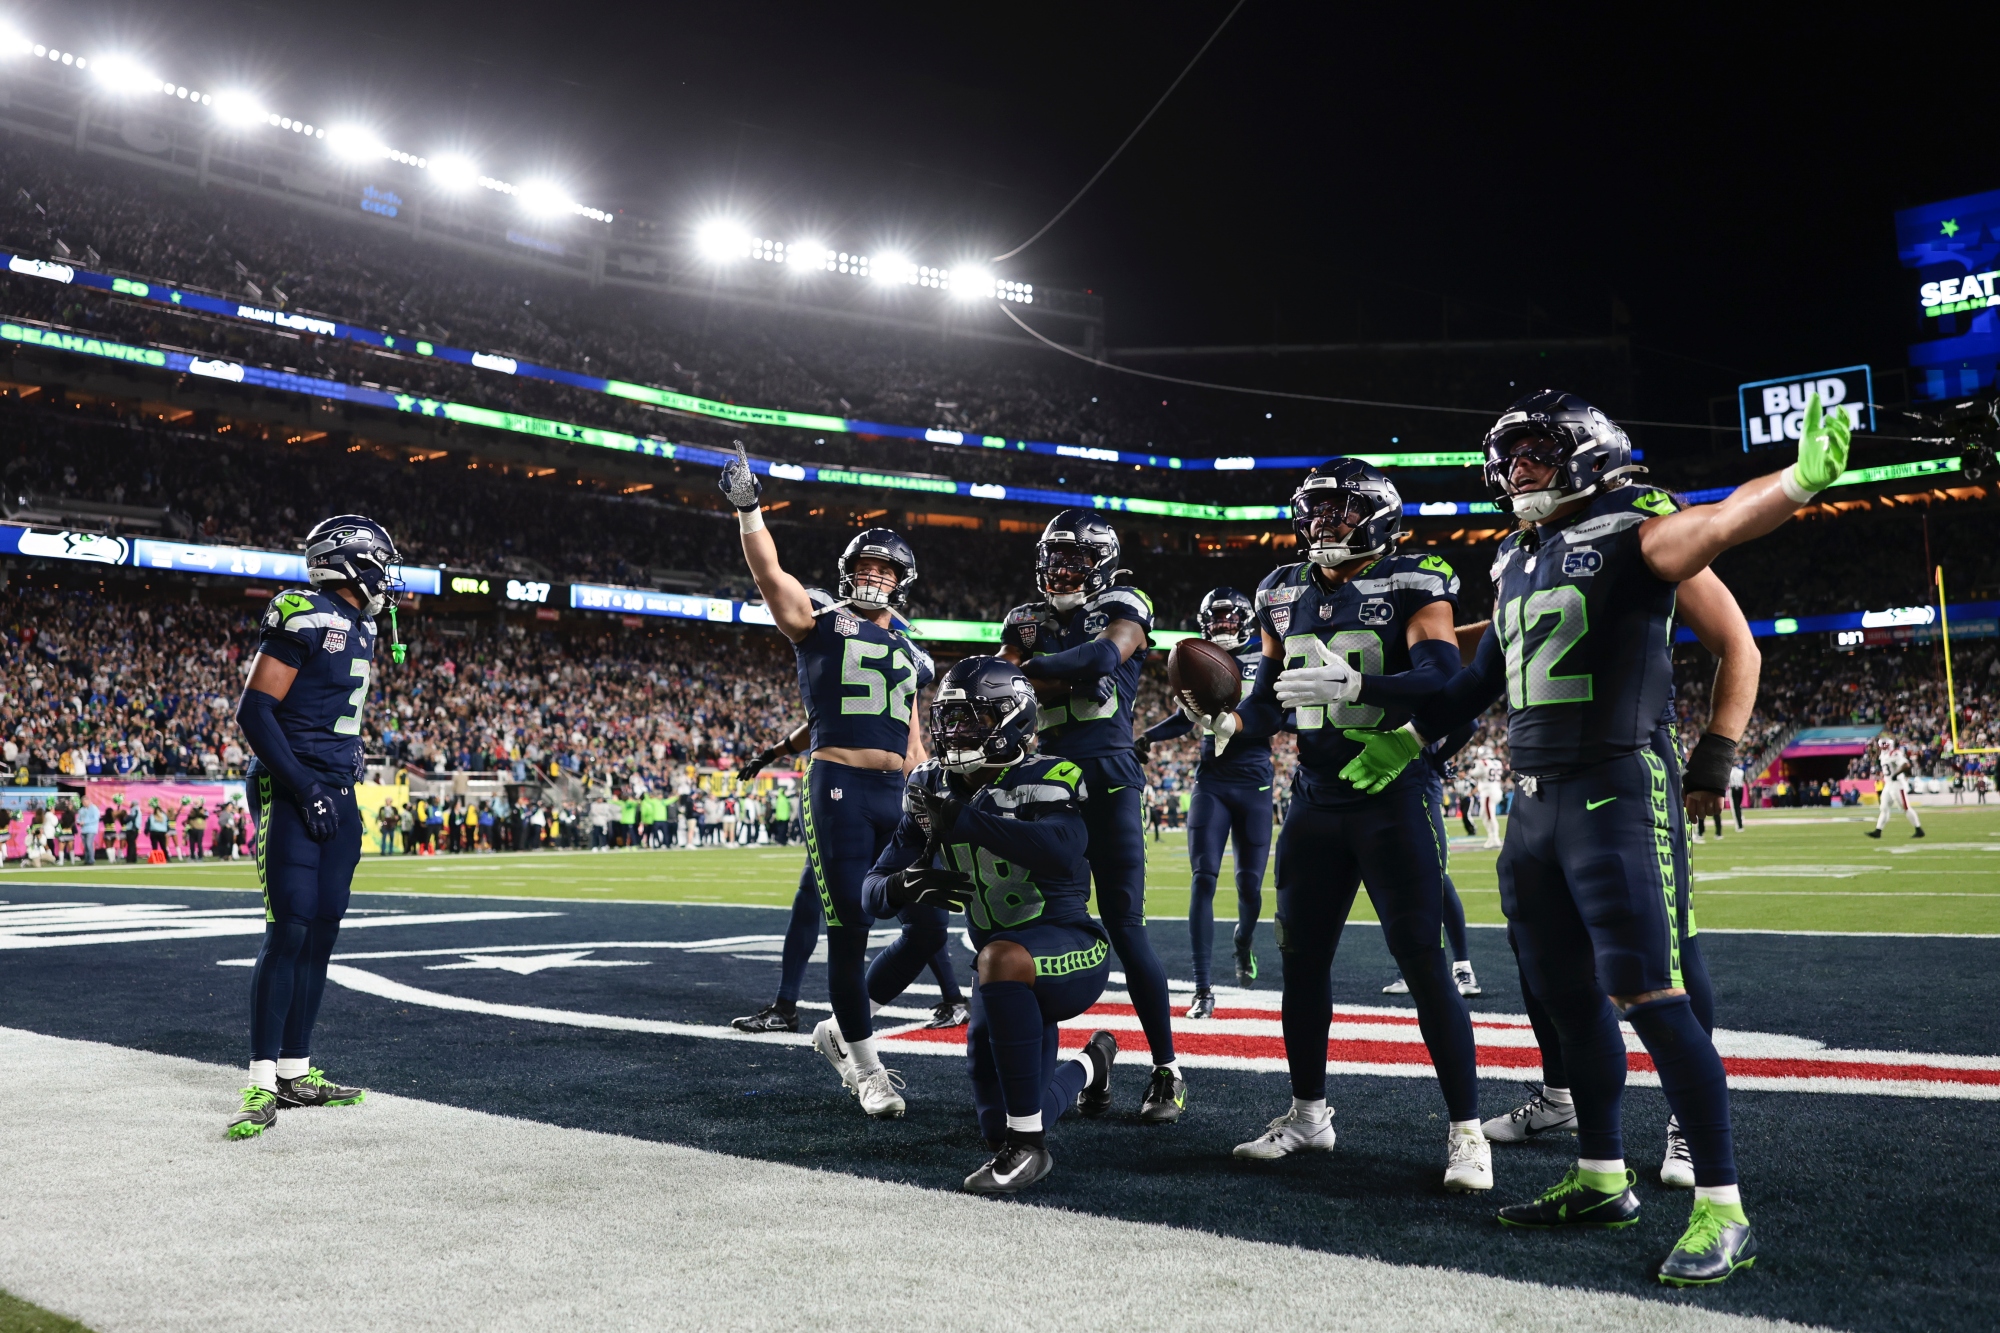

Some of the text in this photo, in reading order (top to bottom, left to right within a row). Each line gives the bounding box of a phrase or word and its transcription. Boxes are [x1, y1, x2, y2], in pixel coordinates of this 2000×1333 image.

[112, 278, 149, 297] 20
[1920, 270, 2000, 307] SEAT
[0, 323, 166, 367] SEAHAWKS
[1762, 377, 1847, 416] BUD
[1749, 402, 1864, 446] LIGT
[818, 469, 957, 494] SEATTLE SEAHAWKS
[1574, 522, 1611, 535] SEAHAWKS
[231, 552, 262, 575] 19
[1564, 551, 1602, 574] 50
[452, 577, 490, 595] QTR 4
[506, 580, 551, 603] 8:37
[582, 589, 612, 608] 1ST
[623, 592, 644, 611] 10
[838, 616, 857, 627] USA
[1085, 614, 1109, 632] 50
[1272, 610, 1288, 619] USA
[1360, 602, 1393, 622] 50
[328, 632, 344, 640] USA
[1020, 627, 1035, 635] USA
[324, 641, 344, 649] 250
[841, 638, 918, 726] 52
[1283, 630, 1386, 730] 20
[333, 658, 371, 736] 3
